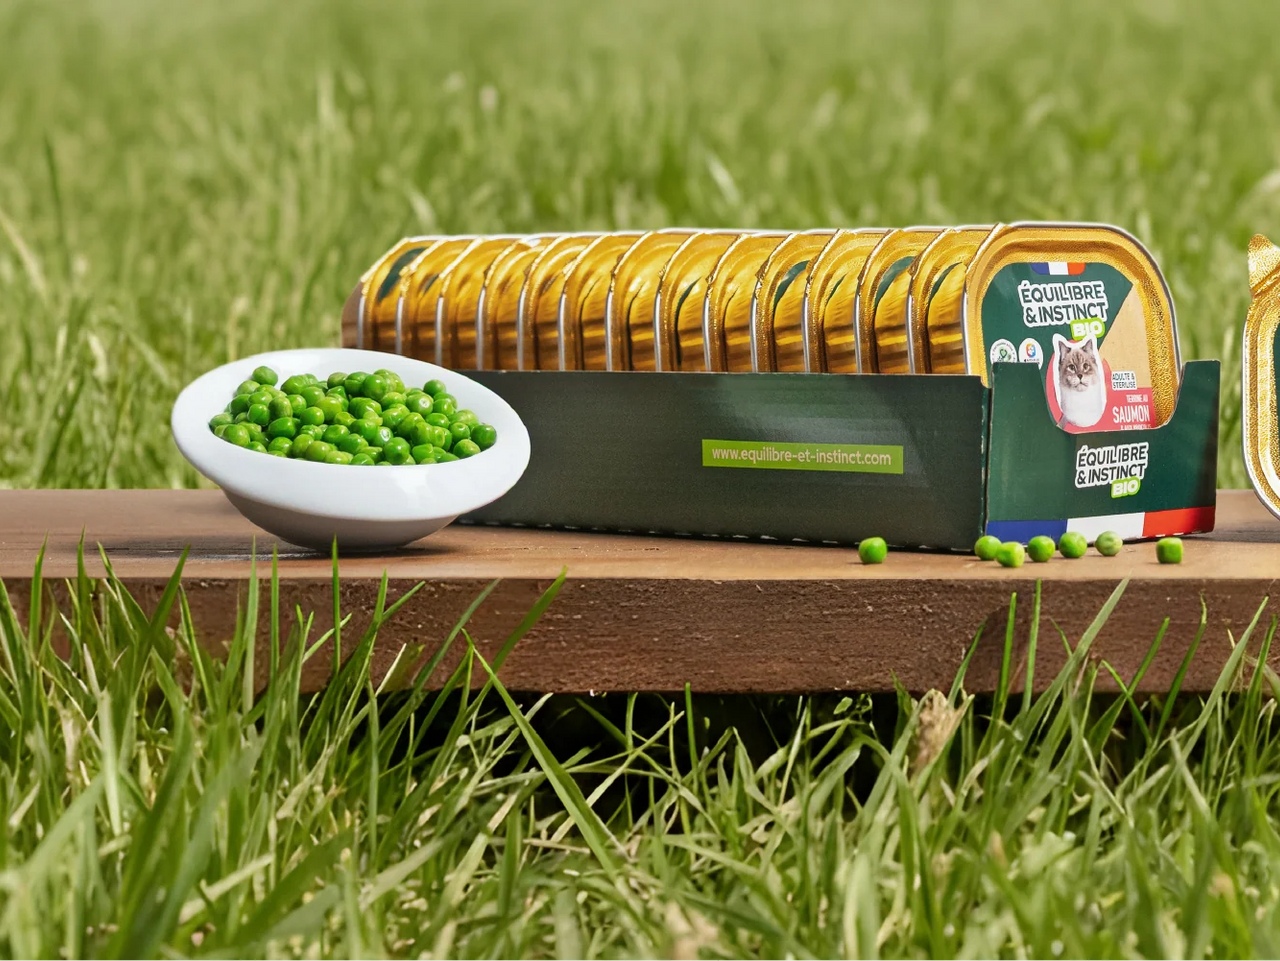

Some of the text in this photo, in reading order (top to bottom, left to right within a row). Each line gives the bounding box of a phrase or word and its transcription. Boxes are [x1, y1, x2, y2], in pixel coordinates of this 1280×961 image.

[1021, 283, 1104, 303] ÉQUILIBRE
[1026, 303, 1106, 323] & INSTINCT
[1073, 321, 1102, 336] BIO
[1112, 404, 1150, 423] SAUMON
[712, 446, 891, 465] www.equilibre-et-instinct.com
[1078, 446, 1147, 467] ÉQUILIBRE
[1077, 463, 1145, 484] & INSTINCT
[1113, 480, 1138, 495] BIO
